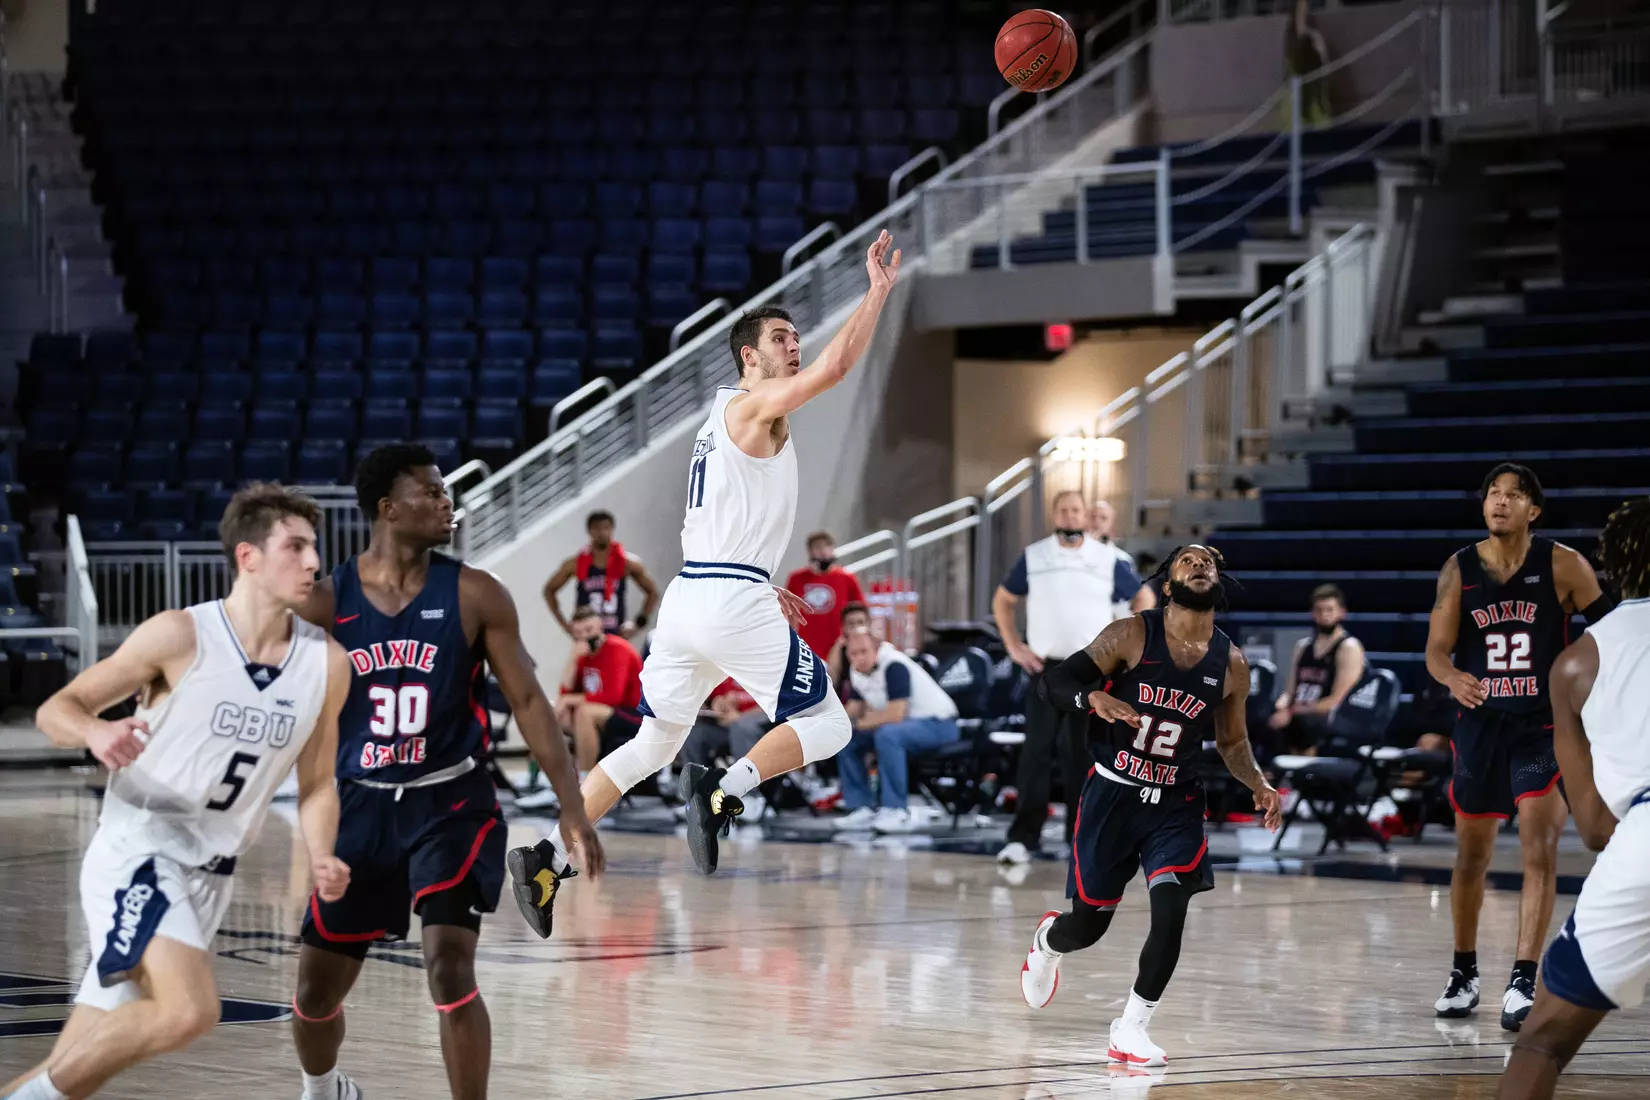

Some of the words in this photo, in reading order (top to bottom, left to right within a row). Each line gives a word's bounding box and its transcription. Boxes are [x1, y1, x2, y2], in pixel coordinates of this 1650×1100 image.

[689, 456, 707, 509] 11
[1471, 600, 1538, 629] DIXIE
[348, 640, 438, 676] DIXIE
[1485, 632, 1532, 671] 22
[1138, 682, 1206, 719] DIXIE
[1480, 676, 1538, 697] STATE
[211, 701, 296, 748] CBU
[368, 683, 431, 739] 30
[1132, 713, 1184, 759] 12
[205, 751, 260, 811] 5
[1114, 750, 1179, 785] STATE
